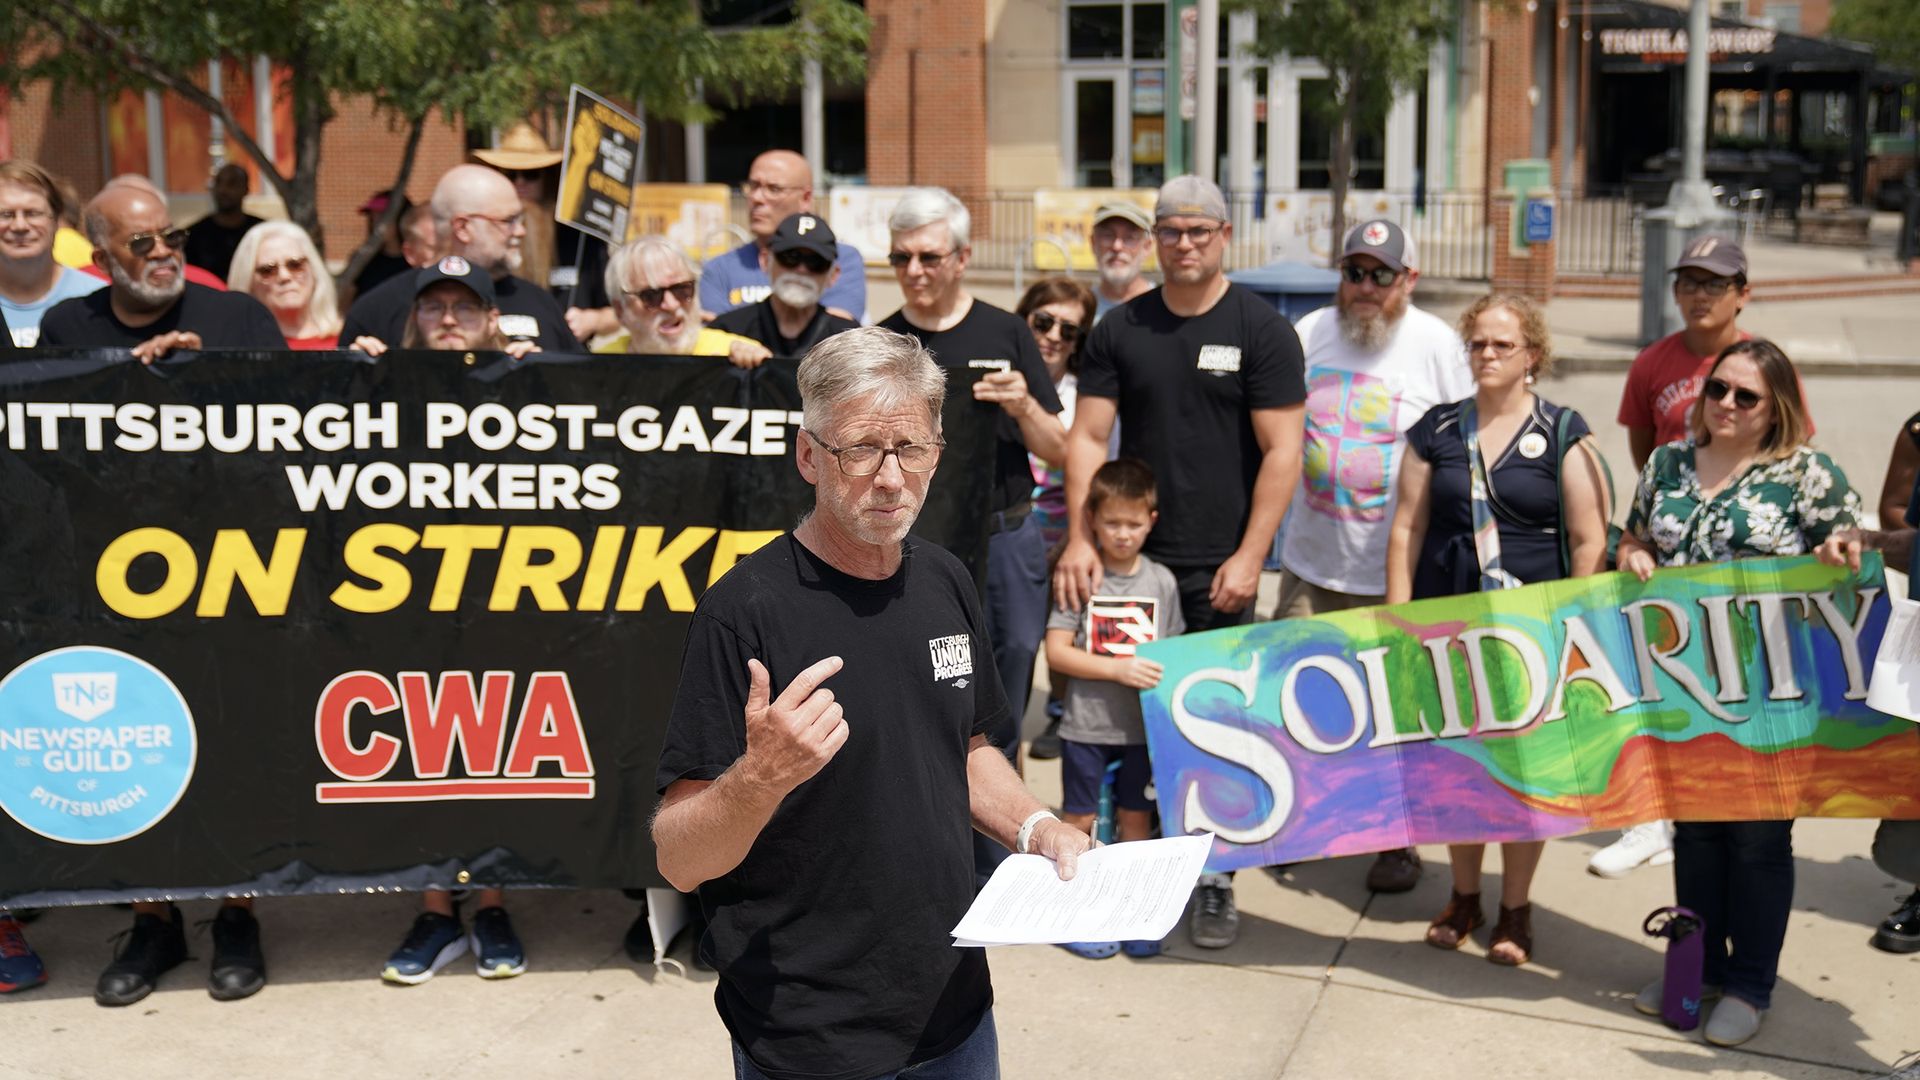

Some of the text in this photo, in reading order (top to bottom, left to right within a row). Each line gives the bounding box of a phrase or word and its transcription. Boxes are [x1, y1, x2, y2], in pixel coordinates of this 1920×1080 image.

[1600, 28, 1689, 54] TEQUILA
[0, 402, 804, 455] ITTSBURGH POST-GAZE
[285, 461, 622, 512] WORKERS
[96, 526, 307, 619] ON
[929, 633, 970, 651] PITTSBURGH
[931, 643, 972, 670] UNION
[61, 681, 110, 707] TNG
[315, 669, 596, 782] CWA
[1171, 587, 1882, 845] SOLIDARITY
[0, 723, 173, 751] NEWSPAPER
[43, 750, 133, 773] GUILD
[77, 778, 98, 793] OF
[30, 783, 148, 817] PITTSBURGH
